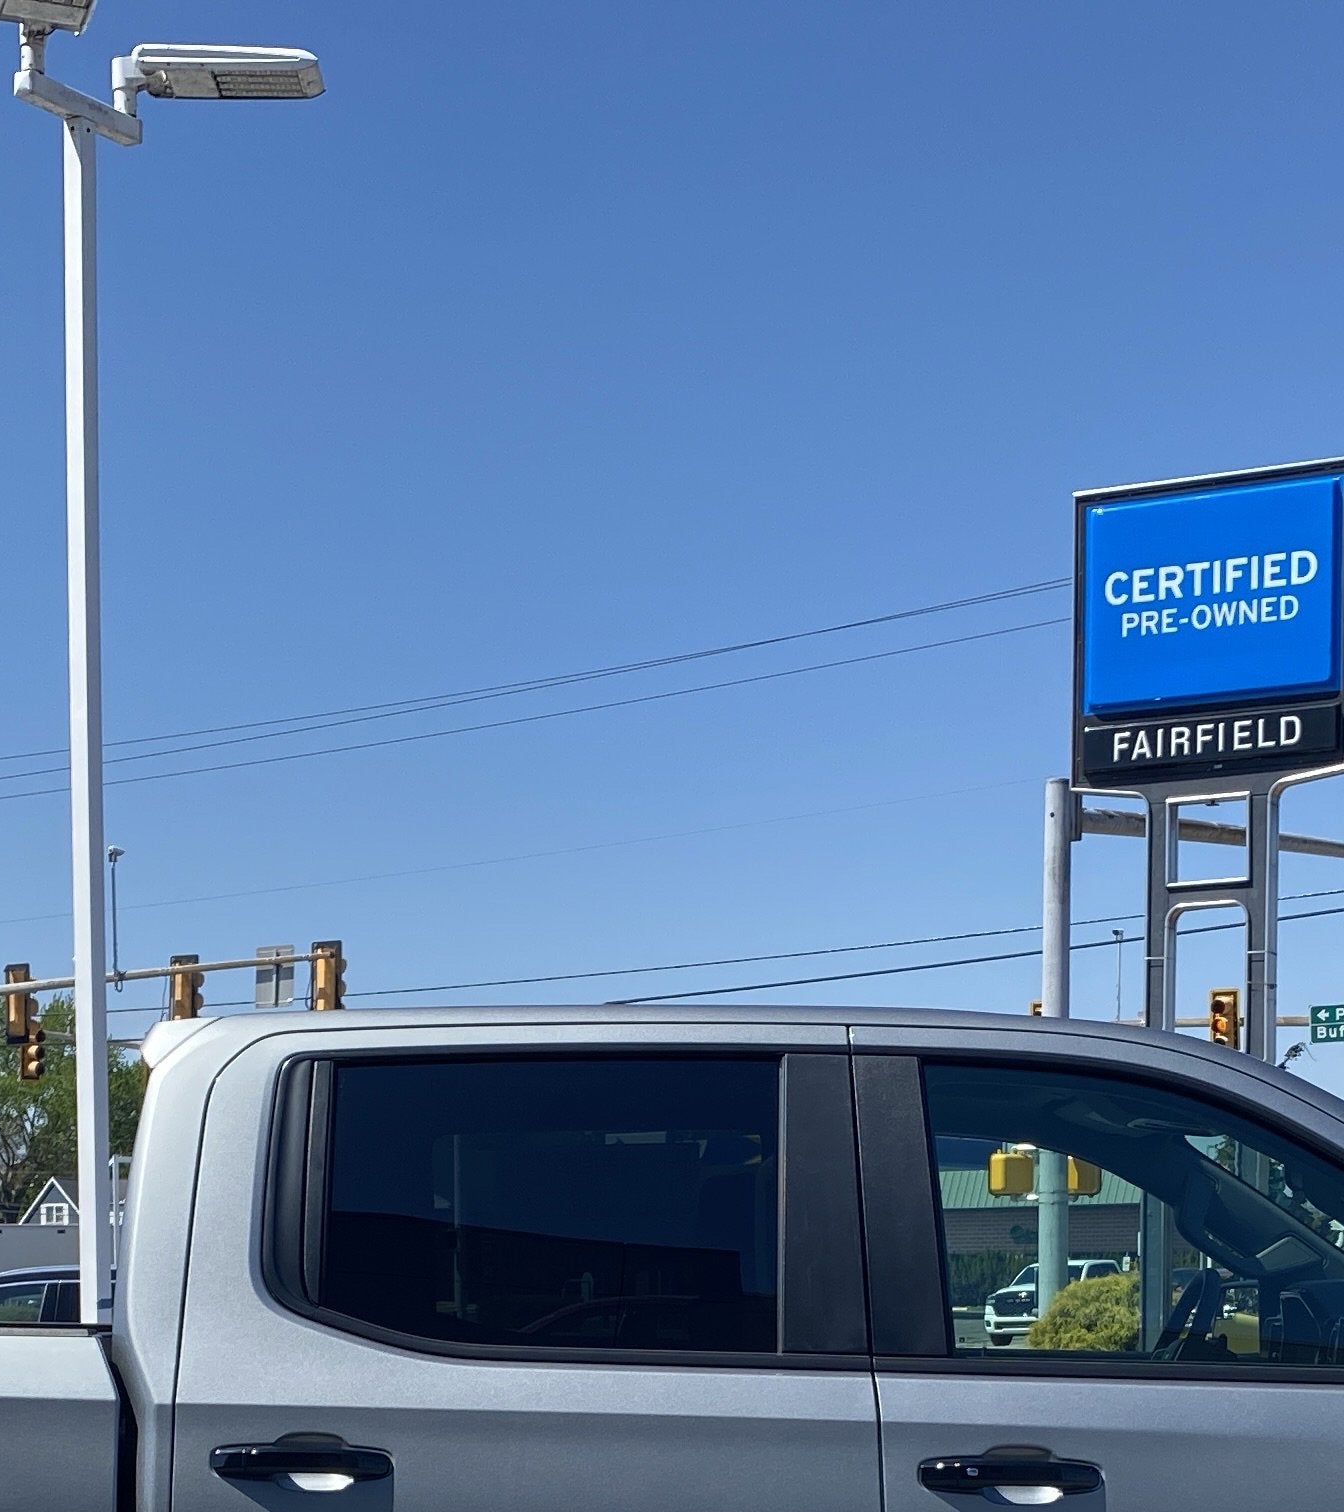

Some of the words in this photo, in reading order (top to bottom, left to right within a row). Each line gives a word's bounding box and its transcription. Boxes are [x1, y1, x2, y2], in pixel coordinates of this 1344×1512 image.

[1105, 549, 1319, 606] CERTIFIED
[1121, 595, 1299, 638] PRE-OWNED
[1113, 715, 1302, 762] FAIRFIELD
